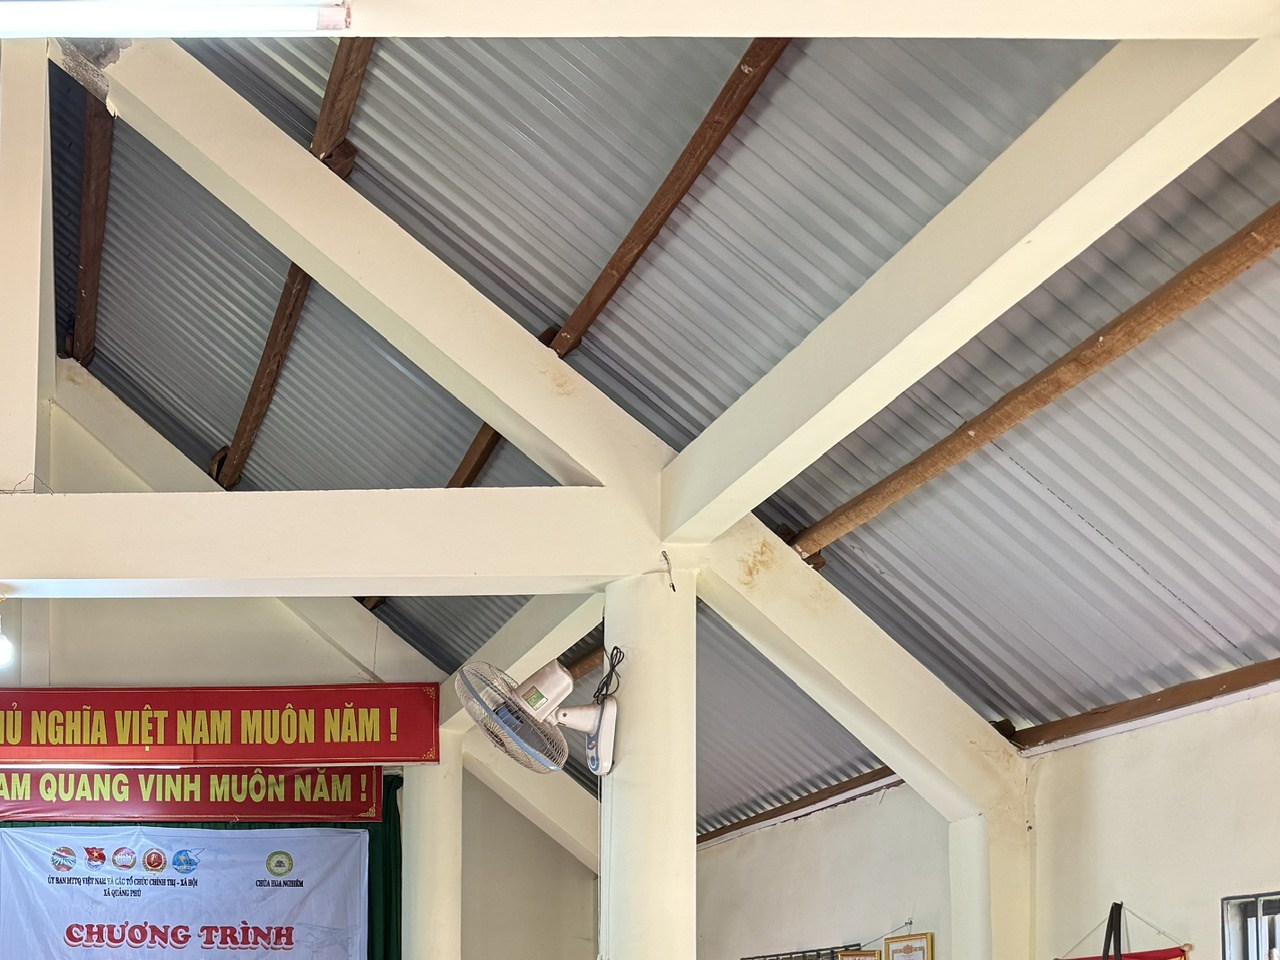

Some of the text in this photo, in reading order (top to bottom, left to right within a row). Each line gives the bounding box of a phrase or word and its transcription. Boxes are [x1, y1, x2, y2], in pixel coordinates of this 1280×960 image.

[31, 704, 108, 745] NGHĨA
[114, 704, 169, 751] VIỆT
[177, 710, 232, 745] NAM
[240, 703, 315, 745] MUÔN
[324, 702, 380, 743] NĂM
[389, 707, 398, 742] !
[38, 772, 129, 804] QUANG
[138, 773, 201, 802] VINH
[209, 768, 285, 802] MUÔN
[294, 767, 352, 802] NĂM
[359, 774, 367, 802] !
[64, 920, 295, 950] CHƯƠNG TRÌNH
